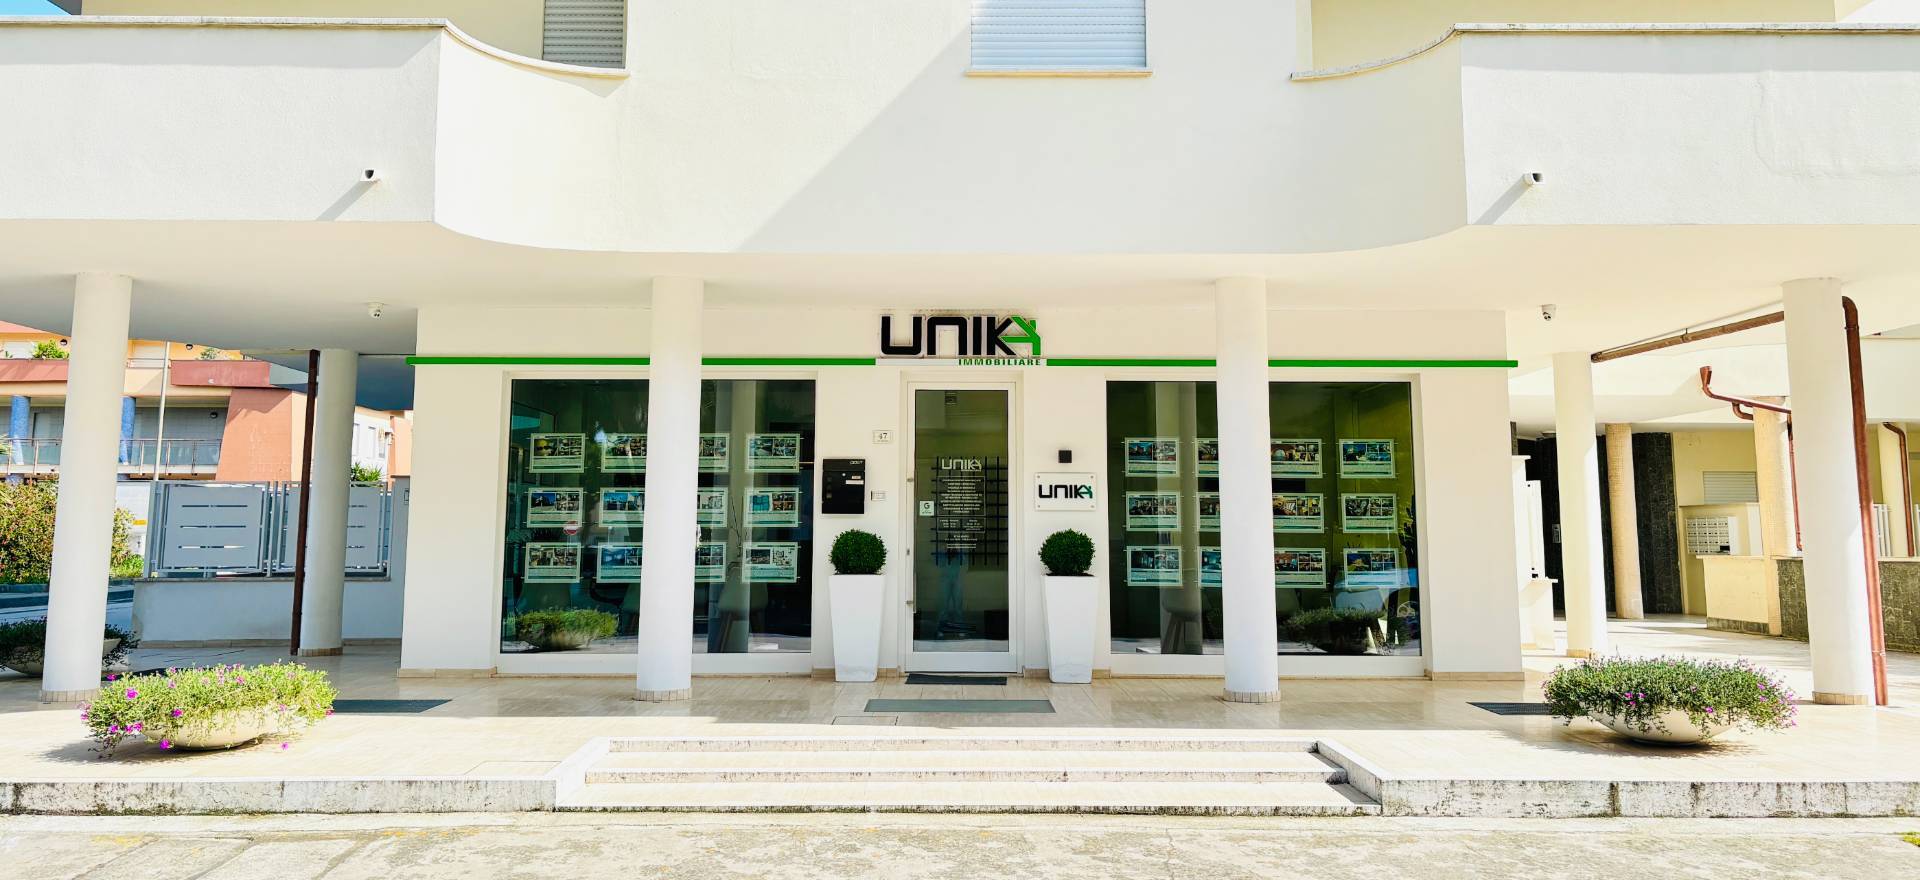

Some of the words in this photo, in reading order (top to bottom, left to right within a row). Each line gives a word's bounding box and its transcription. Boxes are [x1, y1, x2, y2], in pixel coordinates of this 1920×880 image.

[881, 315, 1041, 356] UNIKA
[958, 358, 1041, 366] IMMOBILIARE
[878, 432, 888, 440] 47
[941, 458, 982, 470] UNIKA
[1038, 484, 1093, 499] UNIKA
